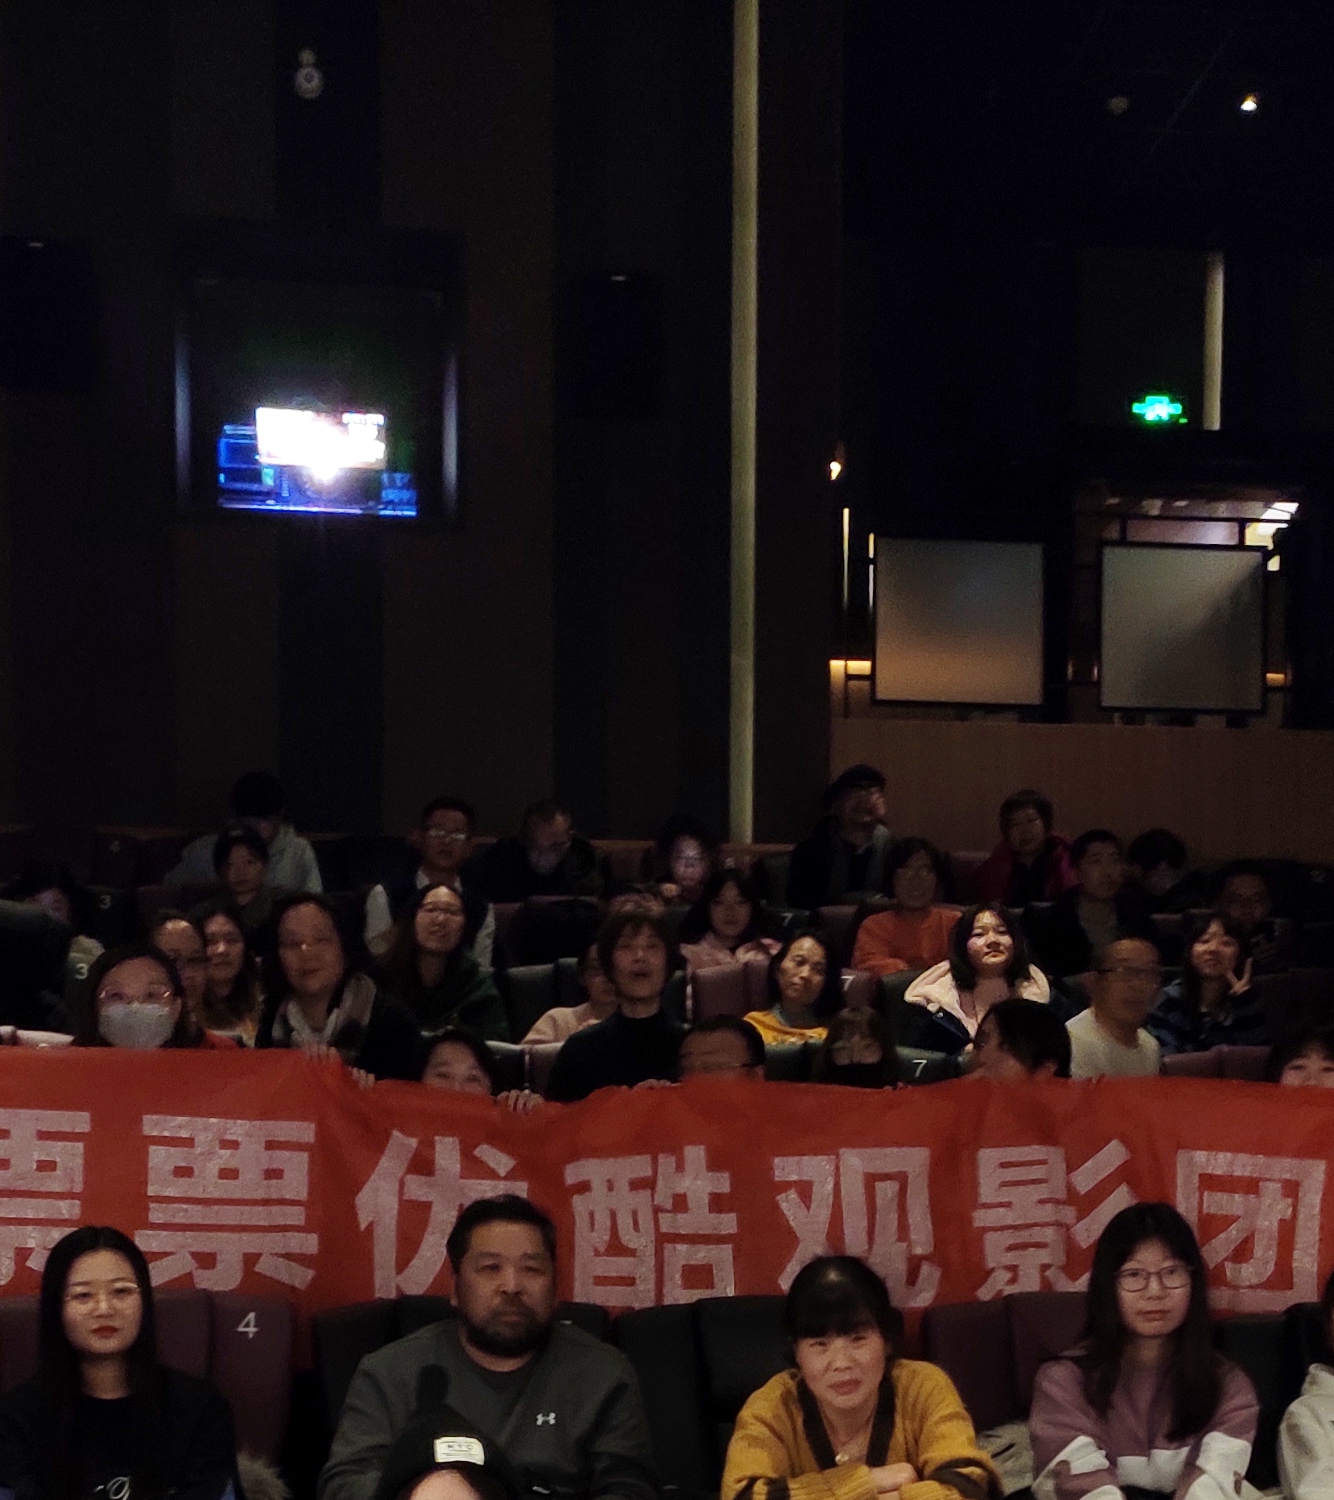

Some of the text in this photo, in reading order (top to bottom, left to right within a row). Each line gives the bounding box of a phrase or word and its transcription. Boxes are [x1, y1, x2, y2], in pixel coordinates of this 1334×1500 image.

[97, 895, 110, 910] 3
[779, 913, 792, 928] 7
[71, 964, 87, 980] 3
[841, 976, 856, 992] 7
[910, 1060, 927, 1078] 7
[237, 1311, 260, 1339] 4
